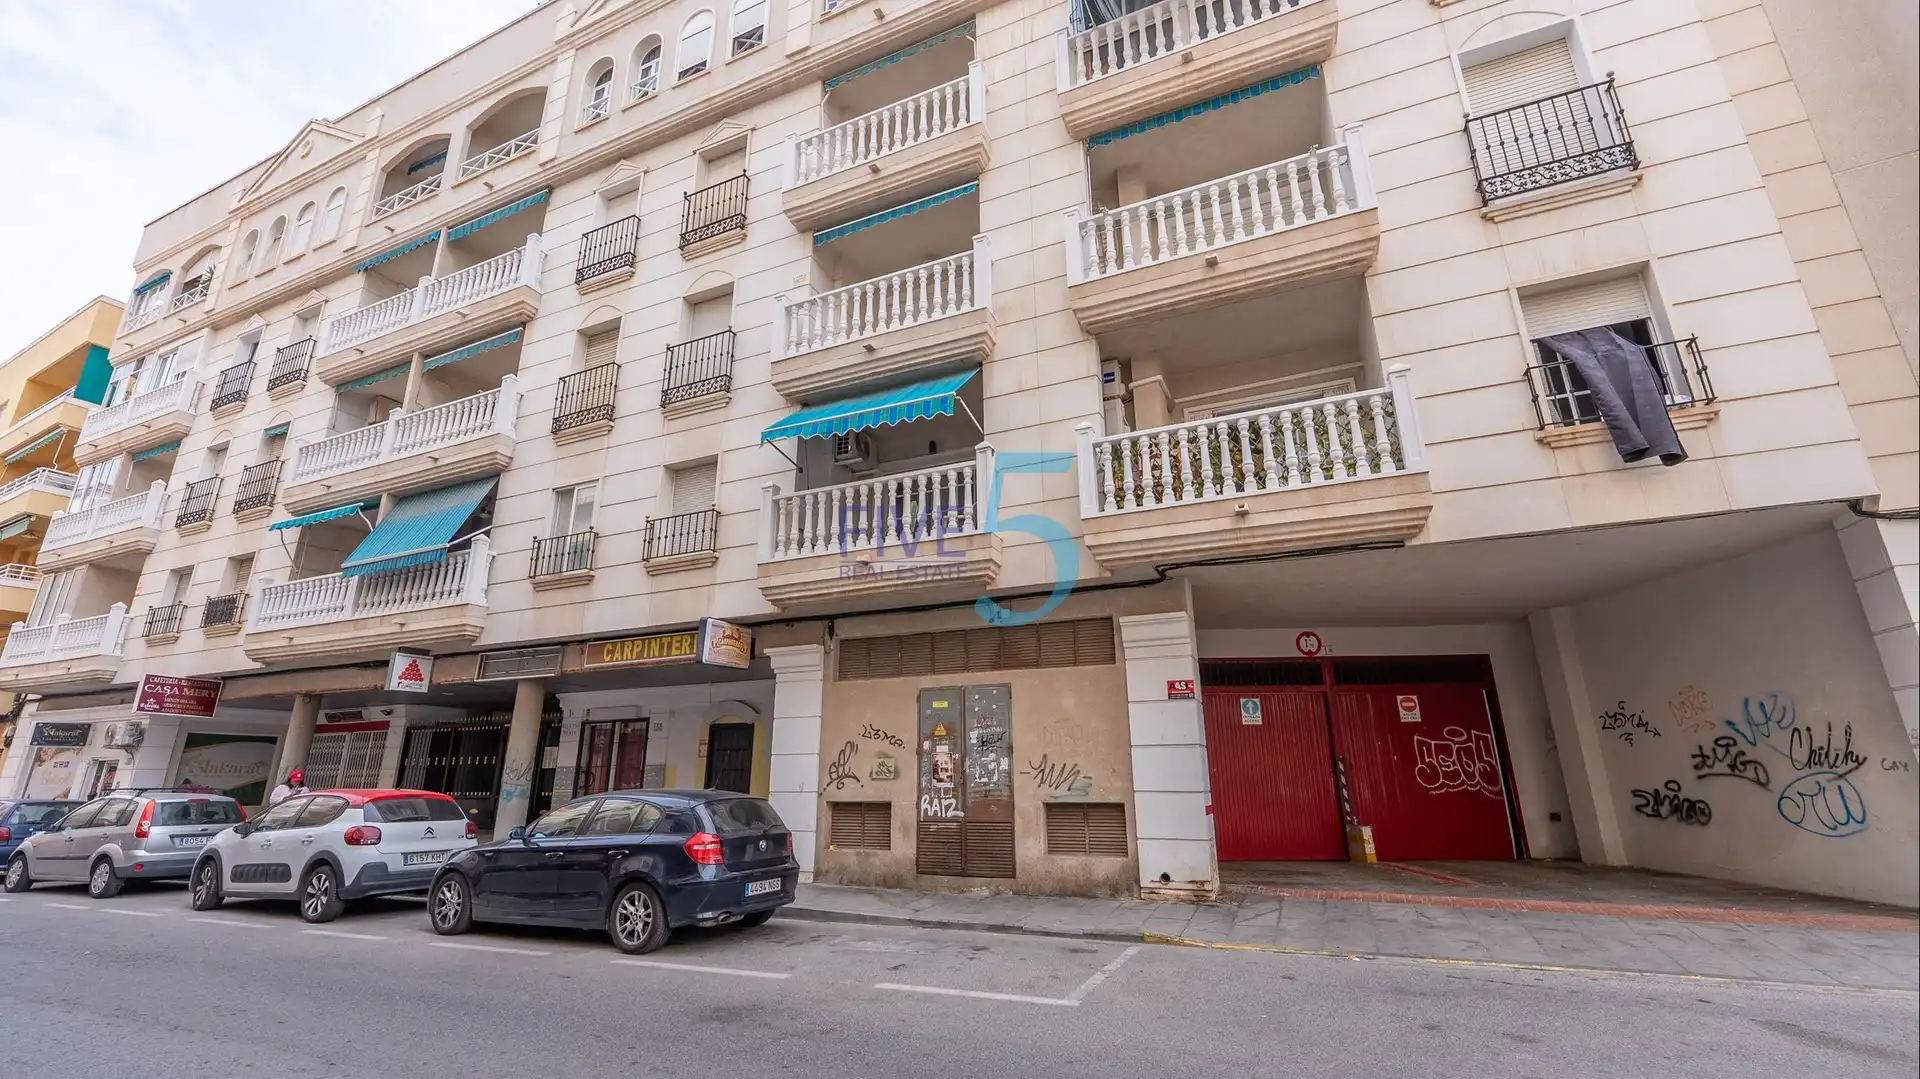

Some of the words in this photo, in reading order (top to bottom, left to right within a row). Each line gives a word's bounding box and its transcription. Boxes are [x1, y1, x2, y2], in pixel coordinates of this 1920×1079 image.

[144, 684, 180, 697] CASA
[183, 687, 217, 698] MERY
[184, 837, 204, 845] 8054
[409, 854, 429, 863] 6157
[432, 852, 445, 861] KHT
[750, 882, 767, 893] 4494
